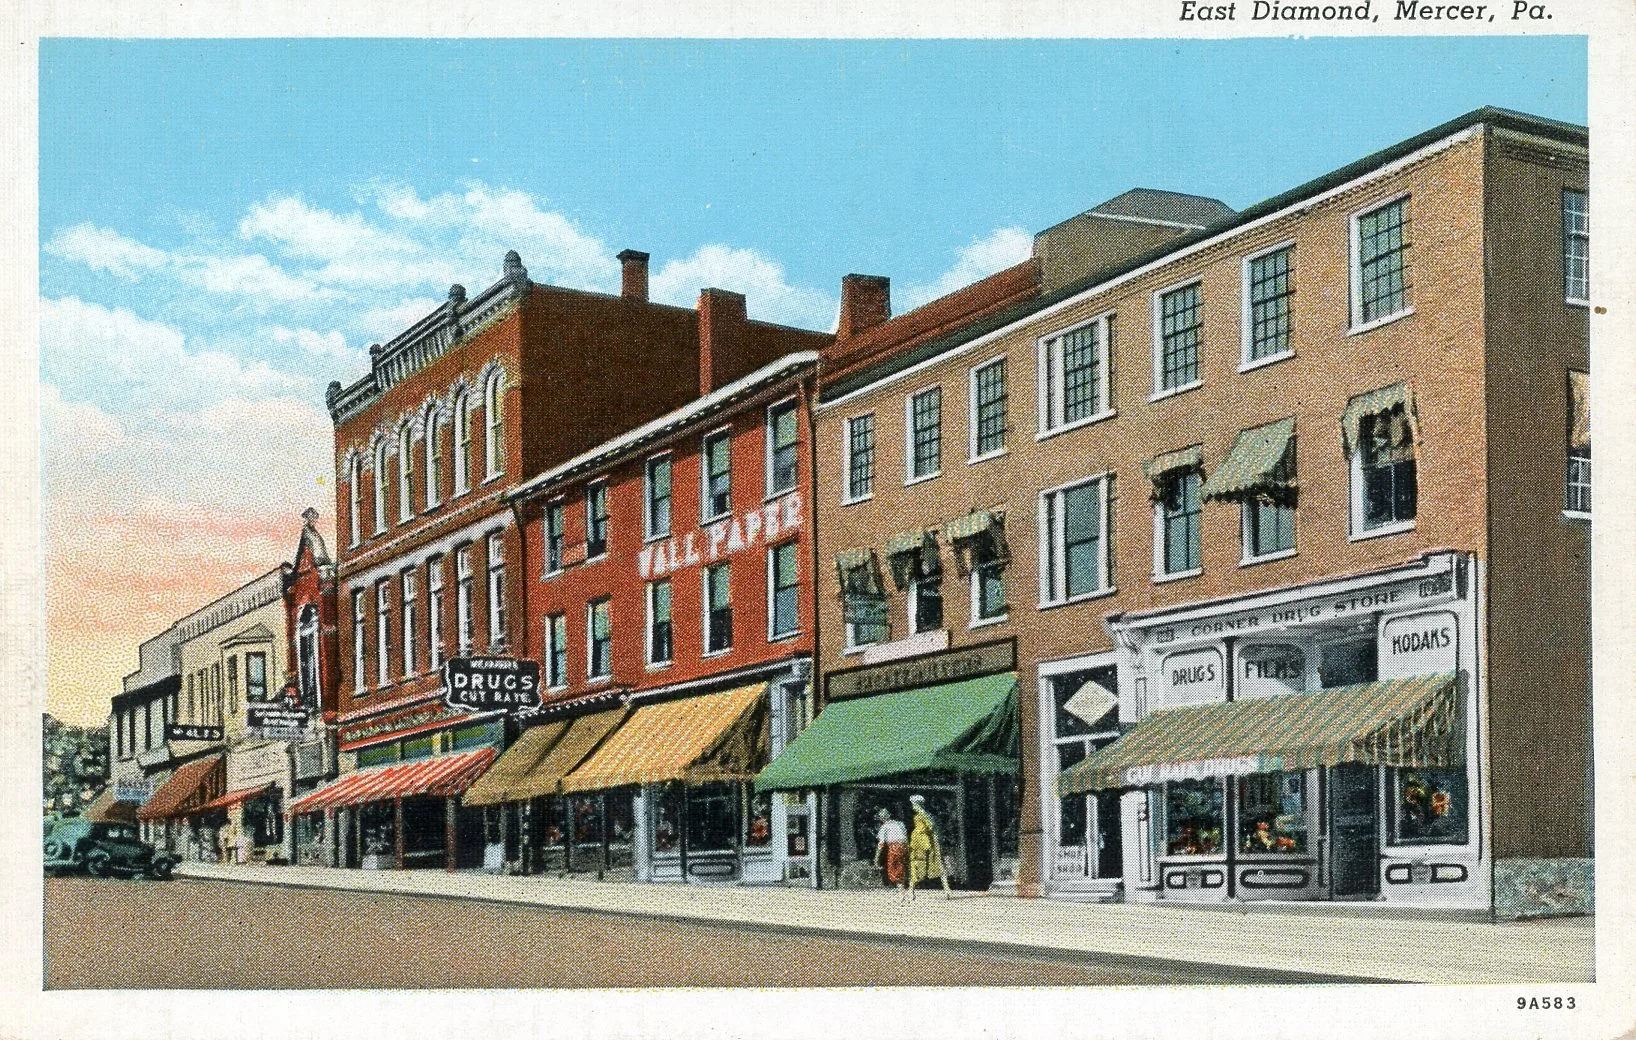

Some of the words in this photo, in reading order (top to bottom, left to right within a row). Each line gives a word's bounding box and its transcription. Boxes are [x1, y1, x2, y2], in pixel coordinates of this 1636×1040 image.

[706, 491, 804, 560] PAPER
[1191, 616, 1260, 637] CORNER
[1272, 606, 1322, 623] DRUG
[1334, 589, 1403, 612] STORE
[1392, 627, 1450, 654] KODAKS
[1172, 663, 1216, 686] DRUGS
[1244, 658, 1301, 680] FILMS
[454, 673, 533, 690] DRUGS
[460, 690, 486, 702] CUT
[494, 692, 531, 703] RATE
